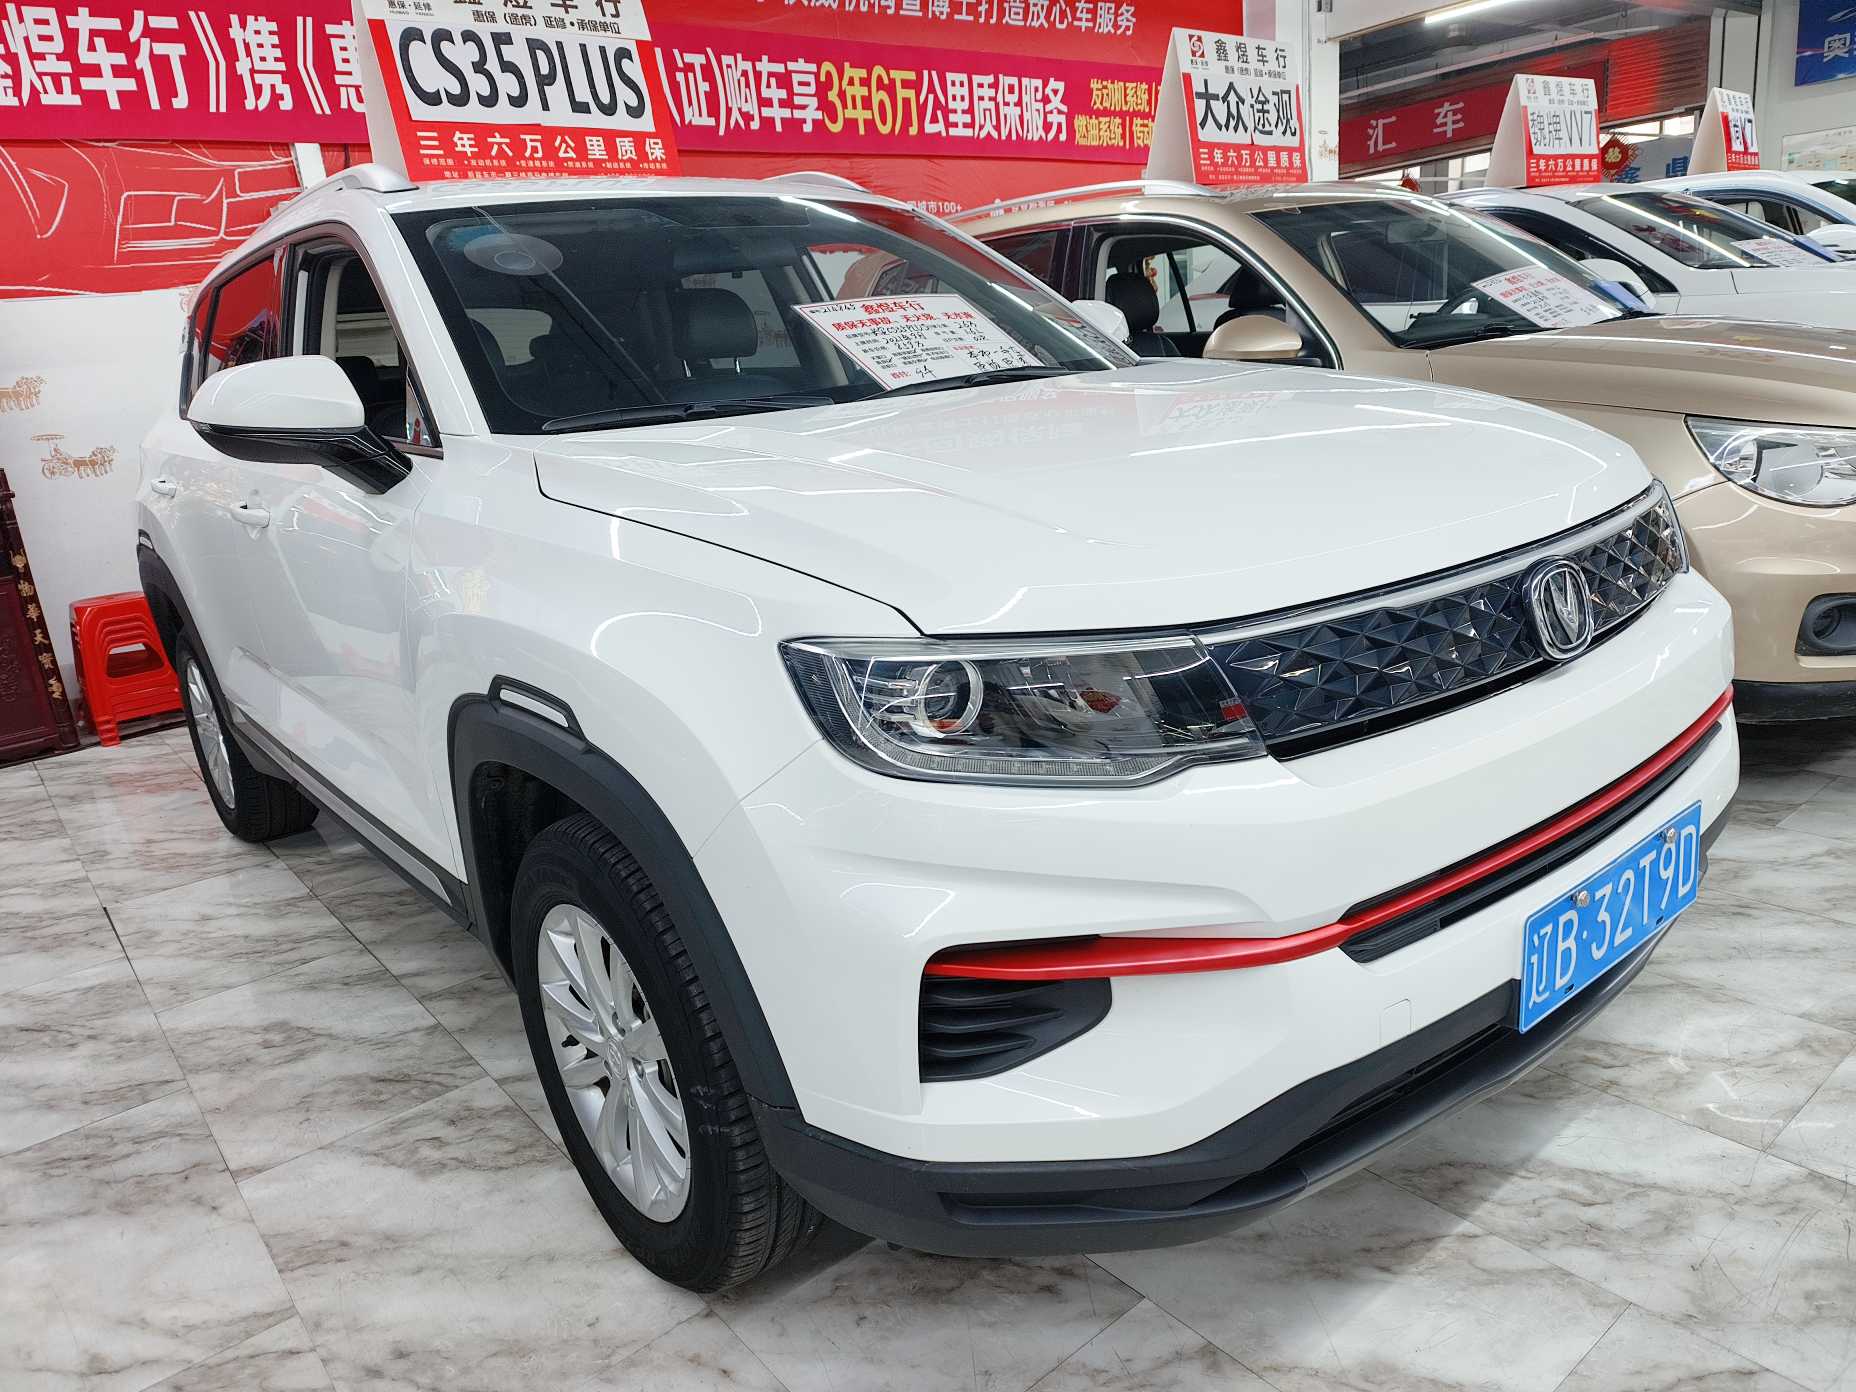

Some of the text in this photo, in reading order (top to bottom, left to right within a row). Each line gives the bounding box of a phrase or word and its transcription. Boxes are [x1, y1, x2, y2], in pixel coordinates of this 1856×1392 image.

[399, 27, 647, 119] CS35PLUS
[1195, 78, 1297, 137] 大众途观
[416, 131, 667, 161] 三年六万公里质保
[1199, 148, 1302, 168] 三年六万公里质保
